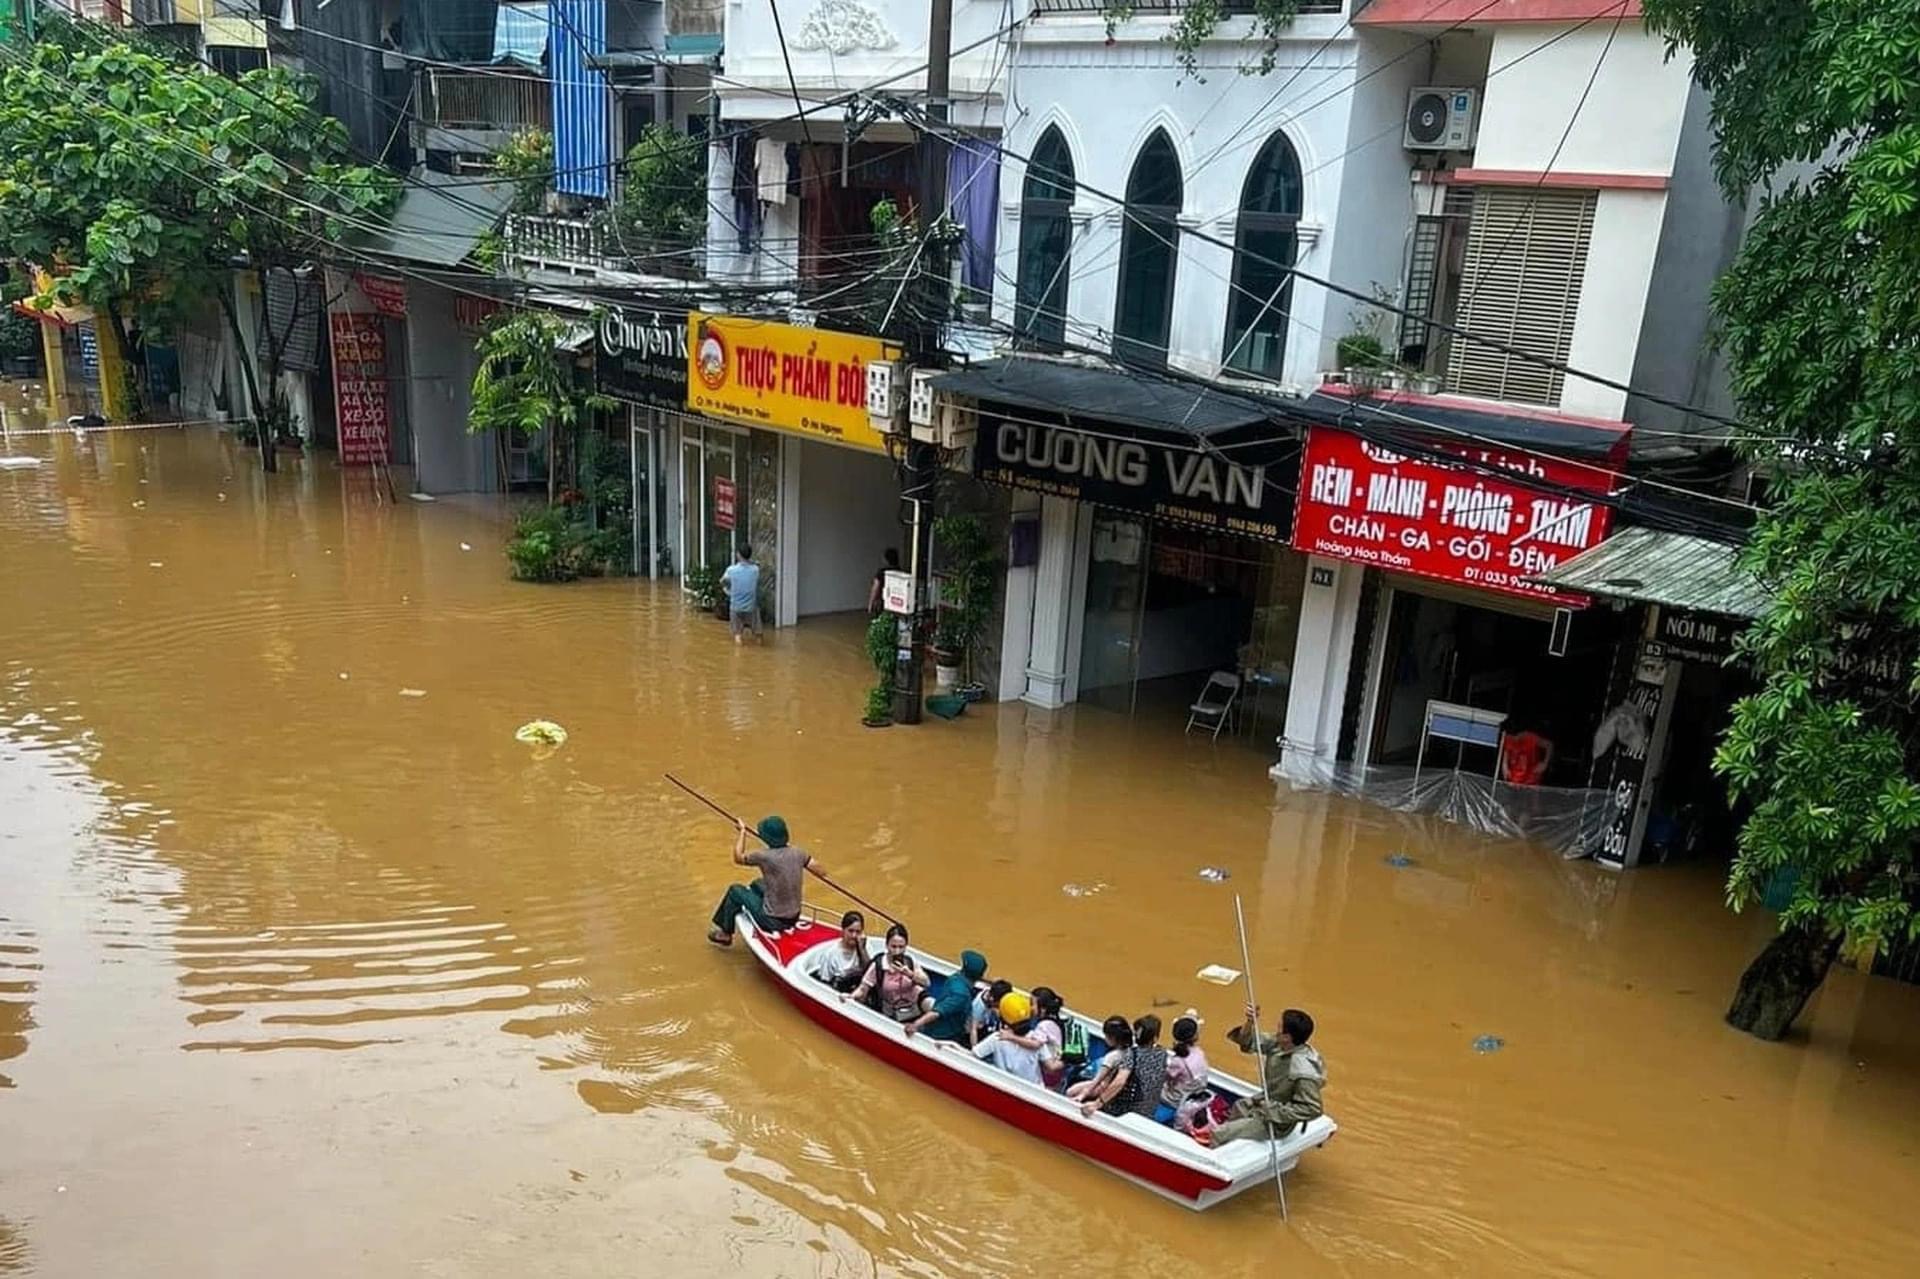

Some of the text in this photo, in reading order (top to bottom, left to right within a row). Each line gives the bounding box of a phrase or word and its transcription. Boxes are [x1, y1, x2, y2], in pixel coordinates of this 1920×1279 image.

[735, 345, 777, 399] THỰC
[781, 339, 832, 402] PHẨM
[1310, 457, 1354, 507] RÈM
[1366, 467, 1428, 520] MÀNH
[1440, 482, 1514, 535] PHÔNG
[1329, 515, 1557, 574] CHĂN GA GỐI ĐỆM
[1666, 613, 1695, 639] NỐI
[1697, 622, 1717, 643] MI
